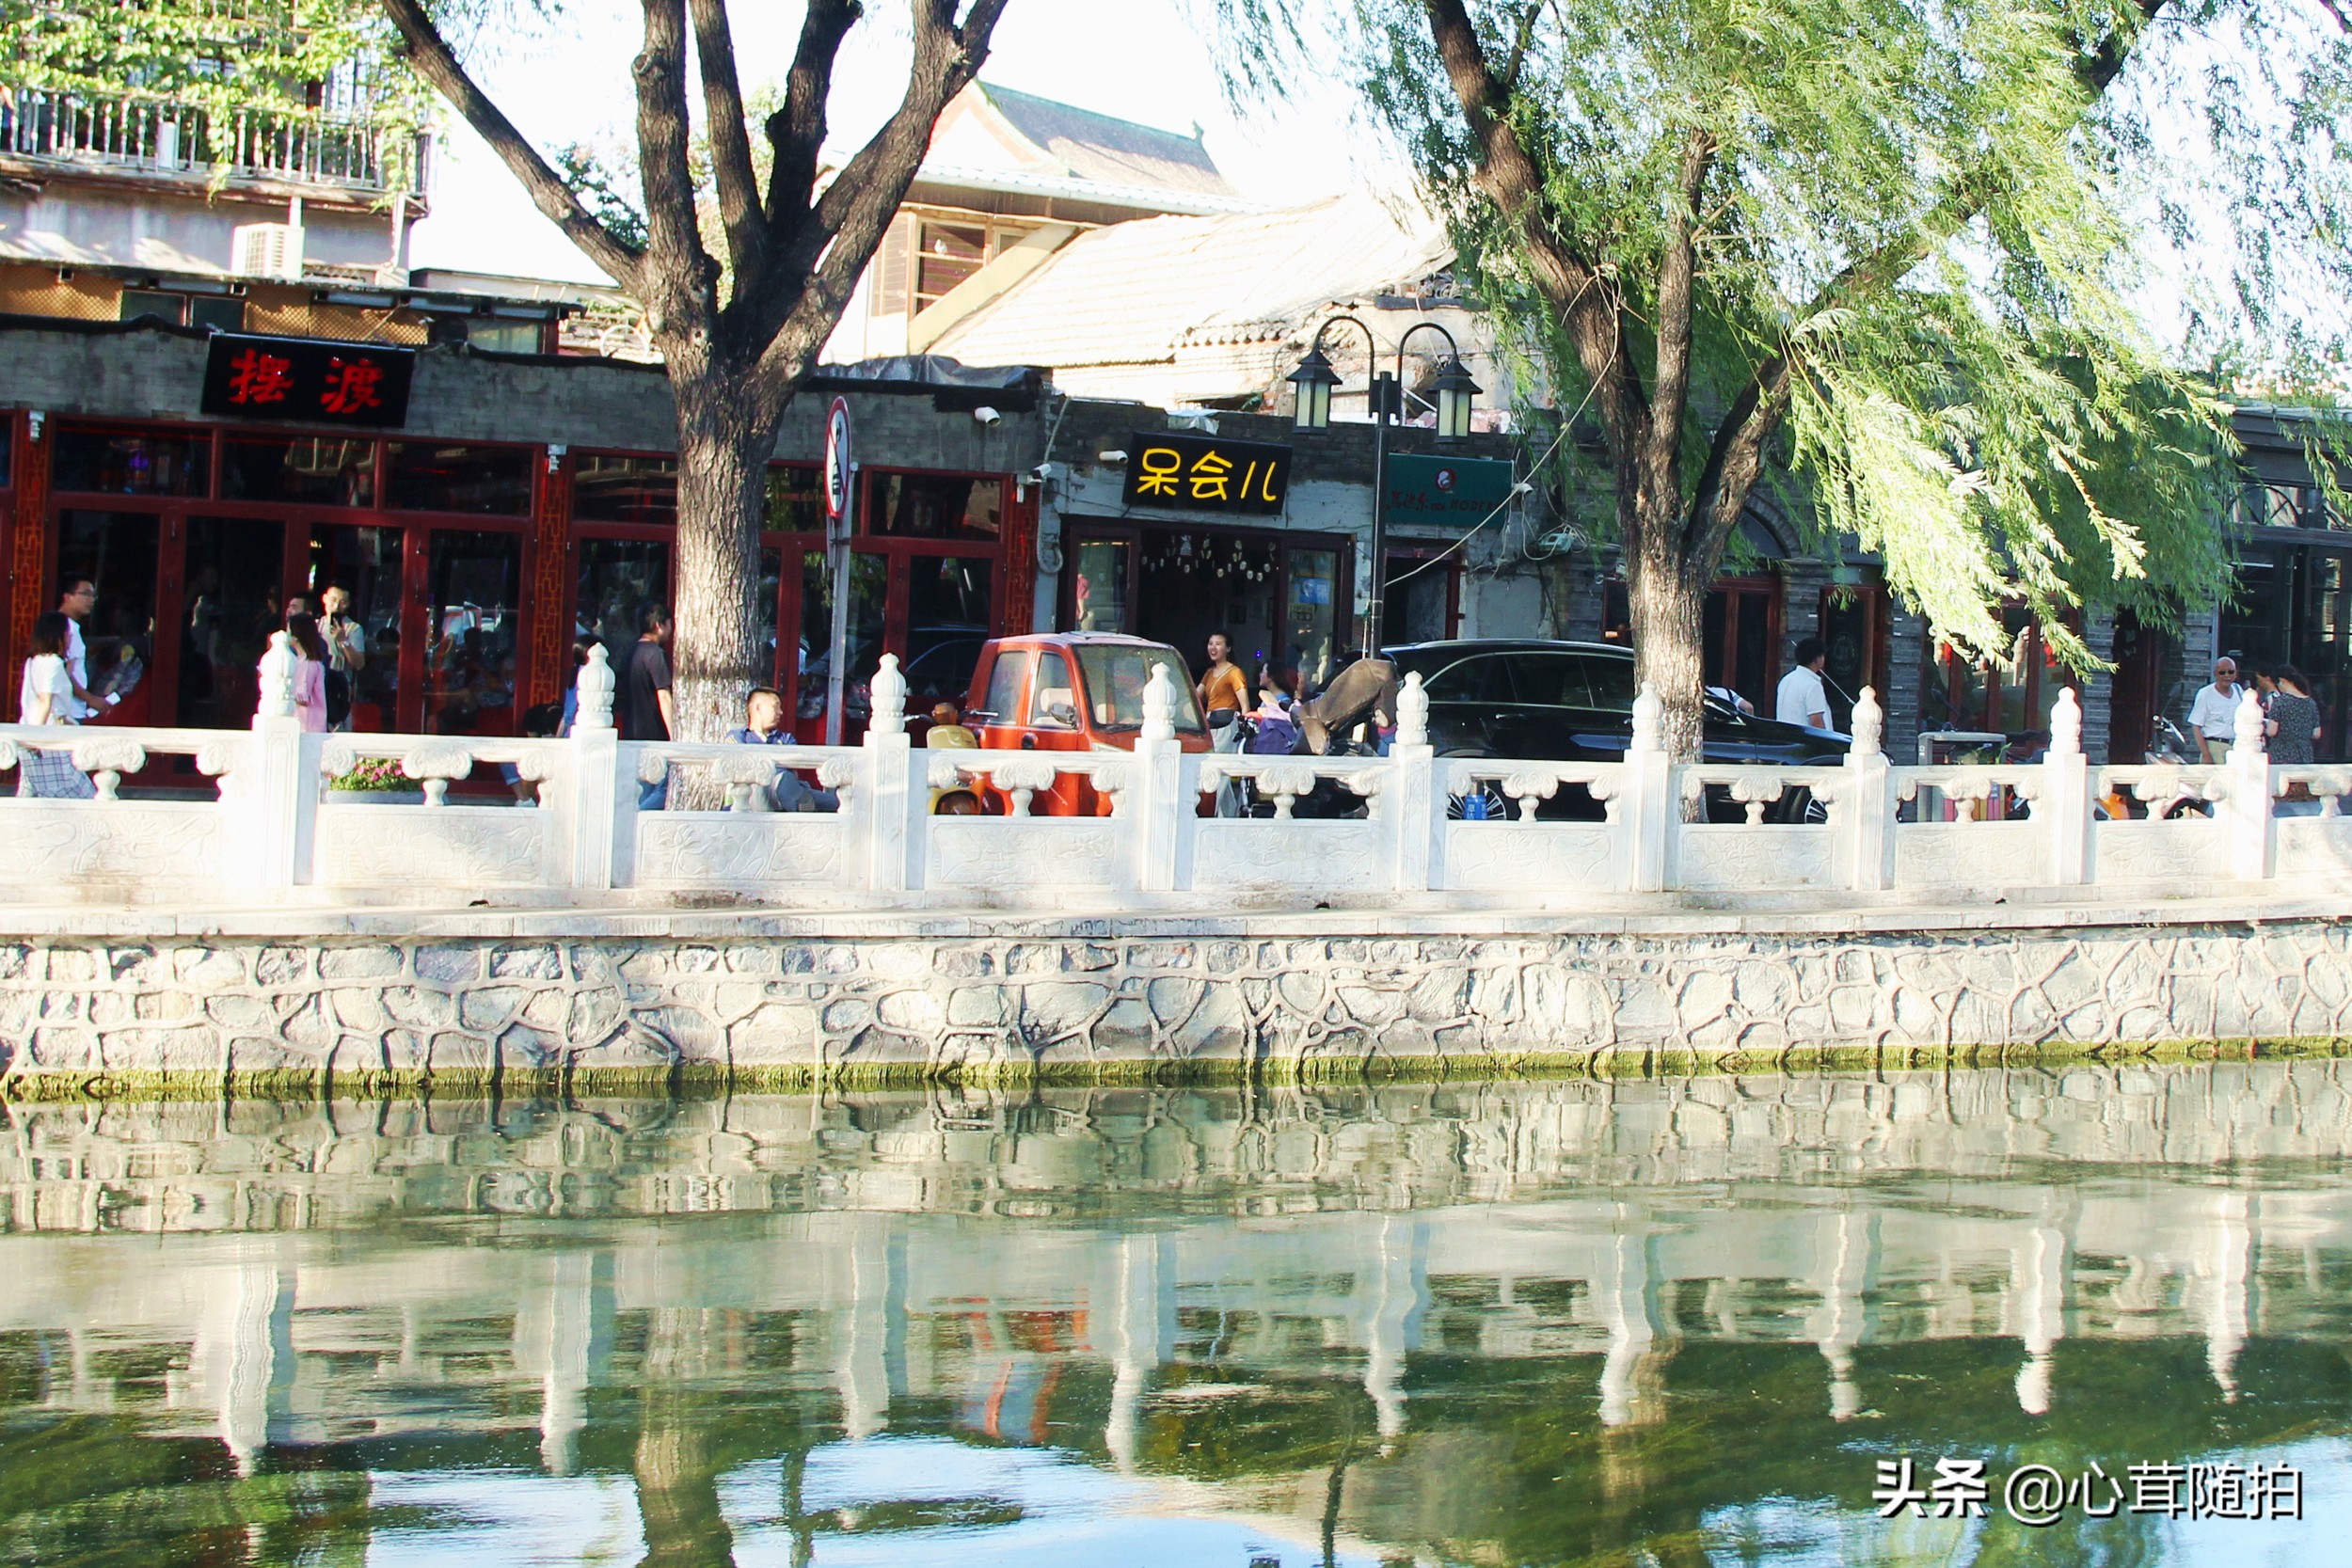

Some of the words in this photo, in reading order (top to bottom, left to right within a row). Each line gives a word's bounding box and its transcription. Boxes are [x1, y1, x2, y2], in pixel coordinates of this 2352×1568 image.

[229, 347, 385, 414] 摆渡
[1136, 447, 1278, 502] 呆会儿
